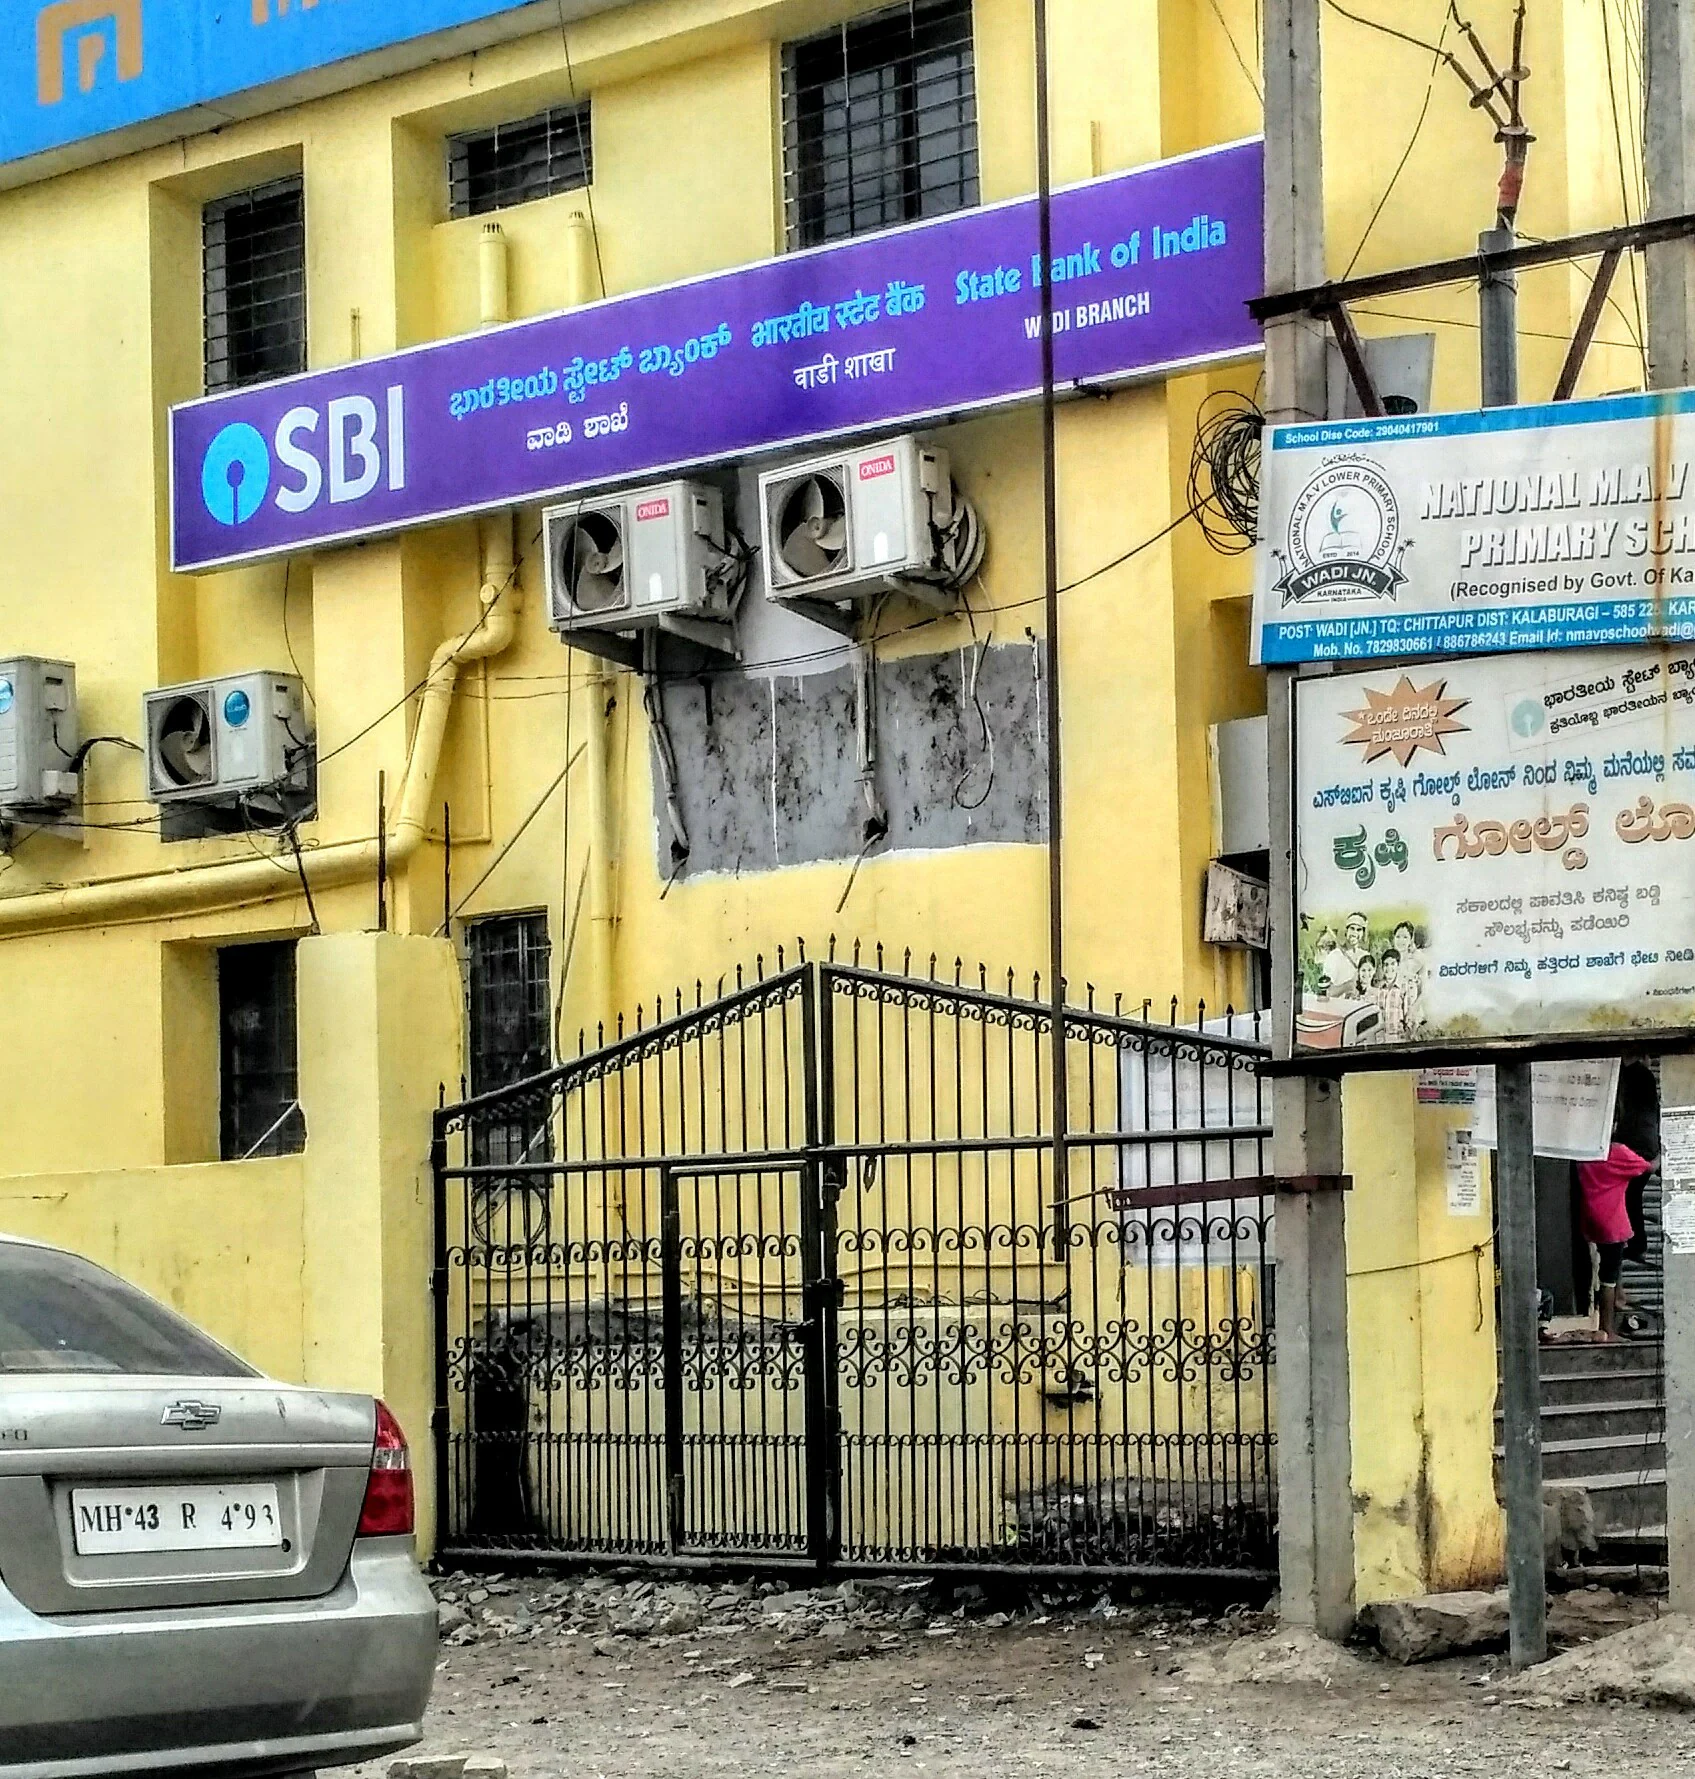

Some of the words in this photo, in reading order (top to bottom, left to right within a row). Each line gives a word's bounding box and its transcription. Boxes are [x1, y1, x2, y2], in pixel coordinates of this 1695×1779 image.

[955, 266, 1021, 304] State
[1110, 230, 1140, 268] of
[1153, 214, 1226, 260] India
[751, 301, 830, 348] भारतीय
[835, 289, 880, 329] स्टेट
[885, 280, 925, 316] बैंक
[1025, 312, 1070, 340] WDI
[1077, 291, 1150, 328] BRANCH
[449, 366, 558, 420] ಭಾರತೀಯ
[562, 356, 633, 404] ಸ್ಟೇಟ್
[639, 322, 732, 377] ಬ್ಯಾಂಕ್
[793, 353, 839, 390] वाडी
[844, 348, 896, 380] शाखा
[526, 421, 573, 451] ವಾಡಿ
[583, 401, 629, 438] ಶಾಖೆ
[1285, 431, 1319, 444] School
[1344, 428, 1373, 439] Code:
[274, 384, 405, 513] SBI
[861, 457, 894, 478] ONIDA
[1322, 471, 1360, 487] LOWER
[1362, 474, 1394, 513] PRIMARY
[1420, 470, 1581, 519] NATIONAL
[637, 501, 668, 520] ONIDA
[1292, 514, 1311, 568] NATIONAL
[1374, 516, 1396, 561] SCHOOL
[1460, 519, 1618, 568] PRIMARY
[1302, 567, 1348, 590] WADI
[1352, 568, 1377, 586] JN.
[1317, 588, 1362, 597] KARNATAKA
[1450, 576, 1558, 601] (Recognised
[1563, 575, 1584, 594] by
[1590, 571, 1637, 589] Govt.
[1644, 568, 1665, 585] Of
[1670, 566, 1694, 583] Ka
[1317, 622, 1347, 638] WADI
[1380, 619, 1400, 634] TQ:
[1404, 613, 1473, 632] CHITTAPUR
[1477, 612, 1509, 627] DIST:
[1512, 606, 1598, 624] KALABURAGI
[1614, 604, 1635, 619] 585
[1314, 643, 1340, 658] Mob.
[1344, 641, 1362, 655] No.
[1366, 637, 1433, 653] 7829830661
[1509, 629, 1543, 646] Email
[1544, 676, 1615, 710] ಭಾರತೀಯ
[1622, 664, 1660, 693] ಸ್ಟೇಟ್
[1603, 691, 1667, 719] ಭಾರತೀಯನ
[1380, 776, 1406, 813] ಕೃಷಿ
[1412, 770, 1461, 806] ಗೋಲ್ಡ್
[1467, 765, 1516, 791] ಲೋನ್
[1523, 758, 1557, 786] ನಿಂದ
[1603, 749, 1665, 782] ಮನೆಯಲ್ಲಿ
[1332, 823, 1409, 890] ಕೃಷಿ
[1433, 802, 1590, 871] ಗೋಲ್ಡ್
[181, 1503, 197, 1529] R
